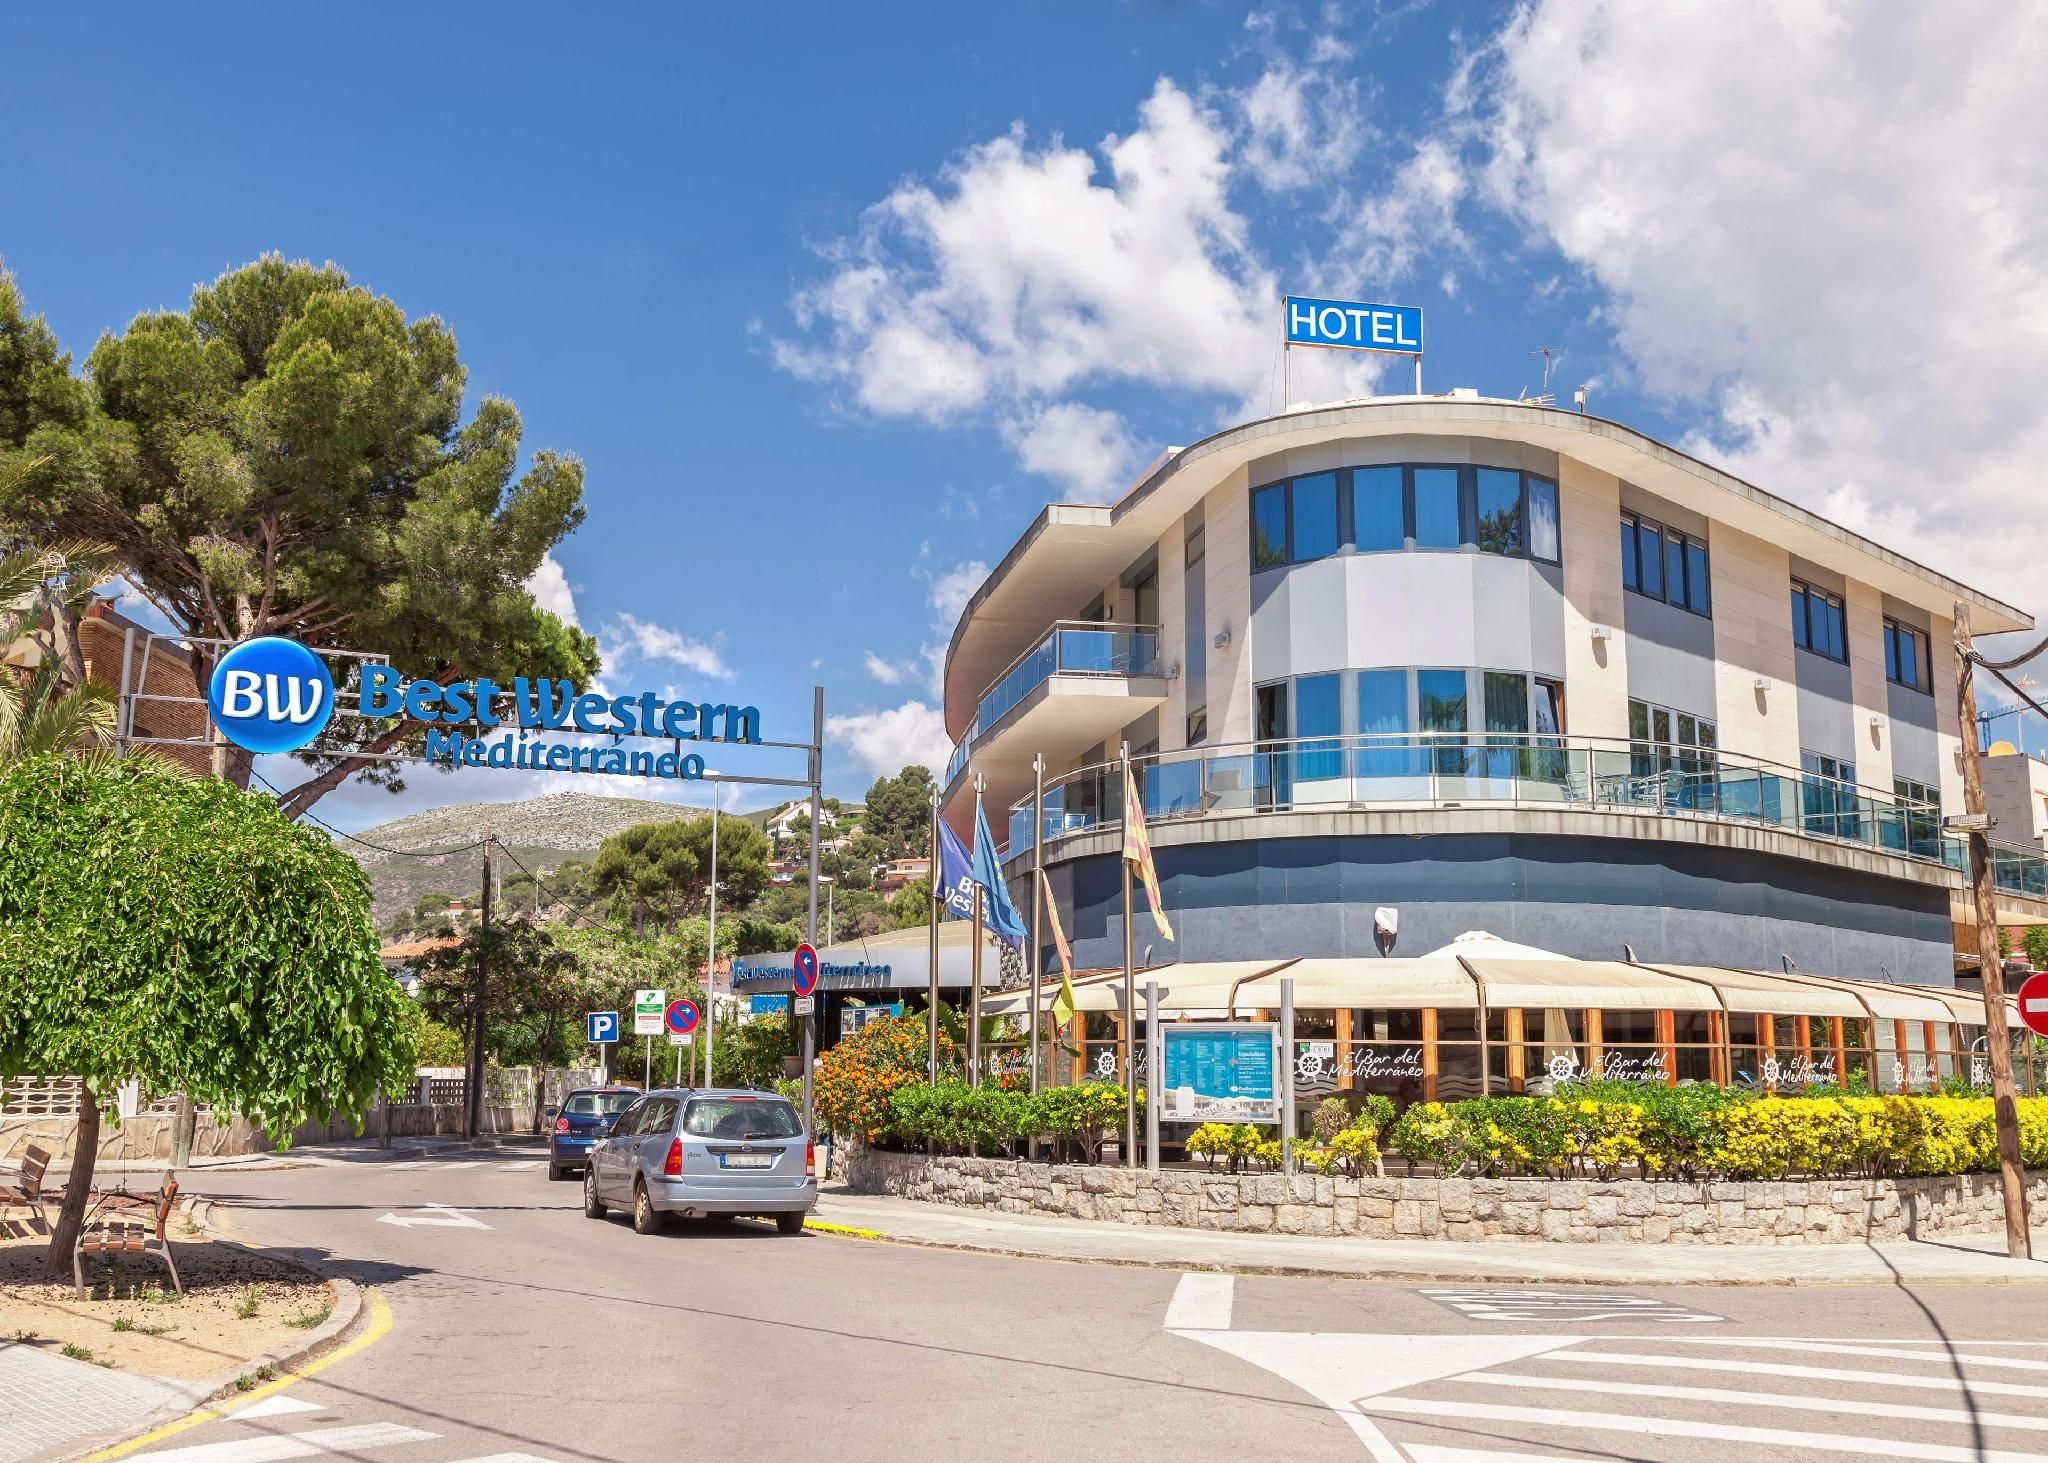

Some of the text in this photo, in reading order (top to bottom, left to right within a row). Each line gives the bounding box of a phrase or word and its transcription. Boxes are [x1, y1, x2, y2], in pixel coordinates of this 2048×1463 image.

[1291, 303, 1417, 345] HOTEL
[221, 669, 324, 724] BW
[359, 664, 763, 745] Best Western
[426, 728, 705, 780] Mediterráneo
[594, 1016, 612, 1039] P
[1327, 1061, 1424, 1079] Mediterráneo
[1343, 1048, 1364, 1064] El
[1363, 1048, 1391, 1065] Bar
[1394, 1048, 1423, 1064] del
[1594, 1051, 1669, 1068] El Bar del
[1419, 1288, 1726, 1323] STOP
